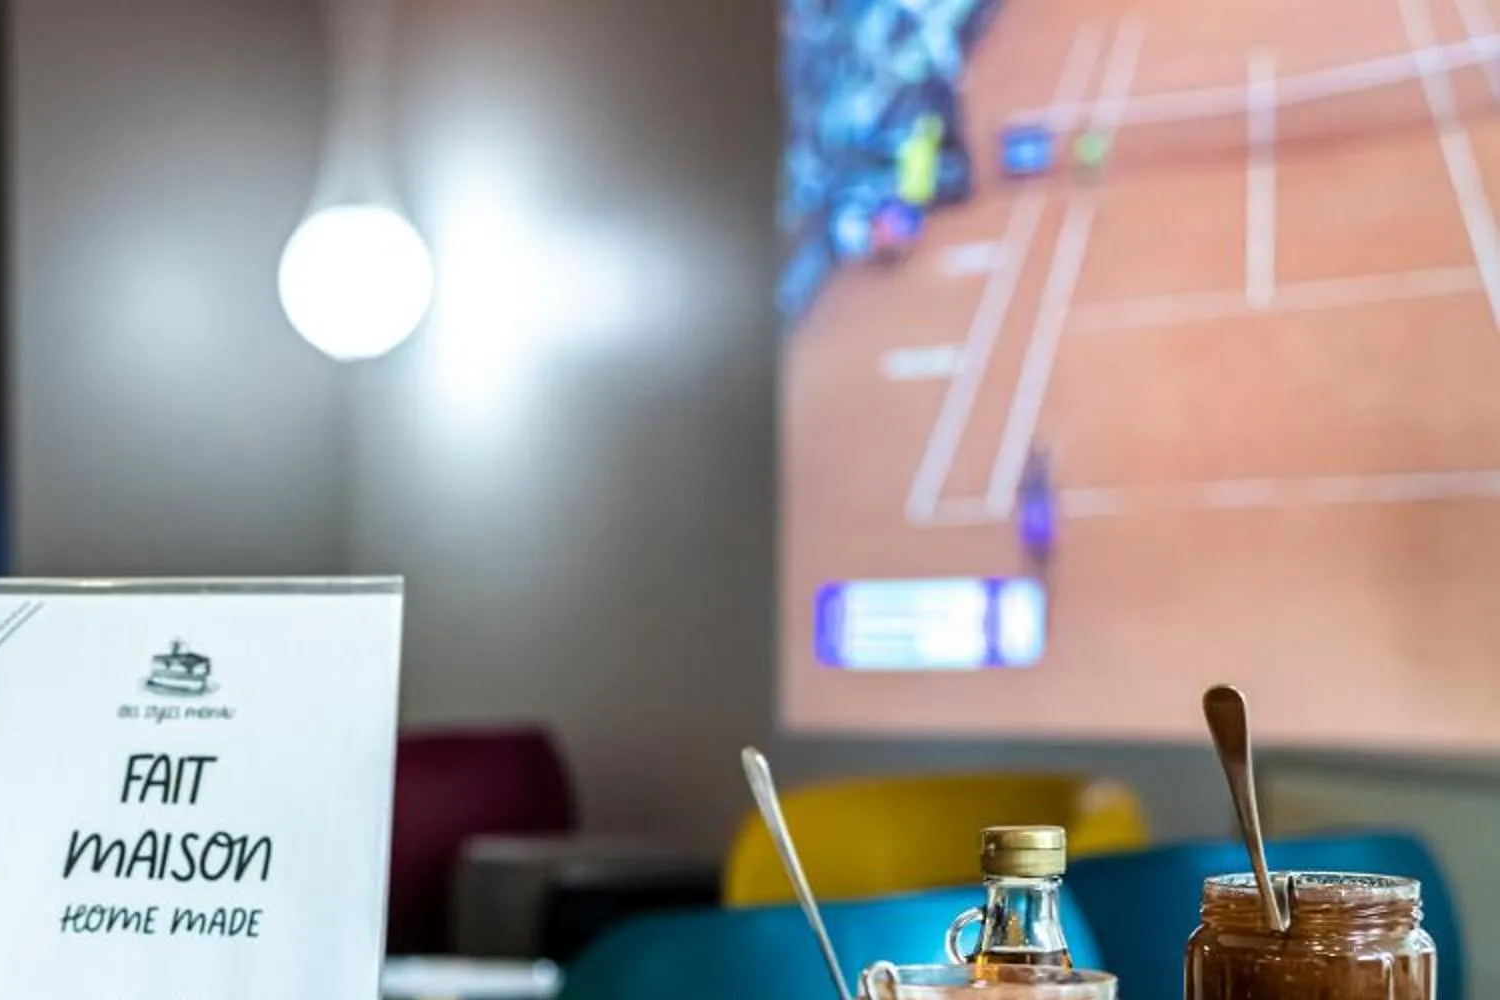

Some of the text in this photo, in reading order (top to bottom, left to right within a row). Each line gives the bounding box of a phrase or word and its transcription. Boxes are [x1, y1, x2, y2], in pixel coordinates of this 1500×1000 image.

[120, 752, 219, 806] FAIT
[62, 828, 273, 884] MAISON
[59, 903, 264, 939] HOME MADE
